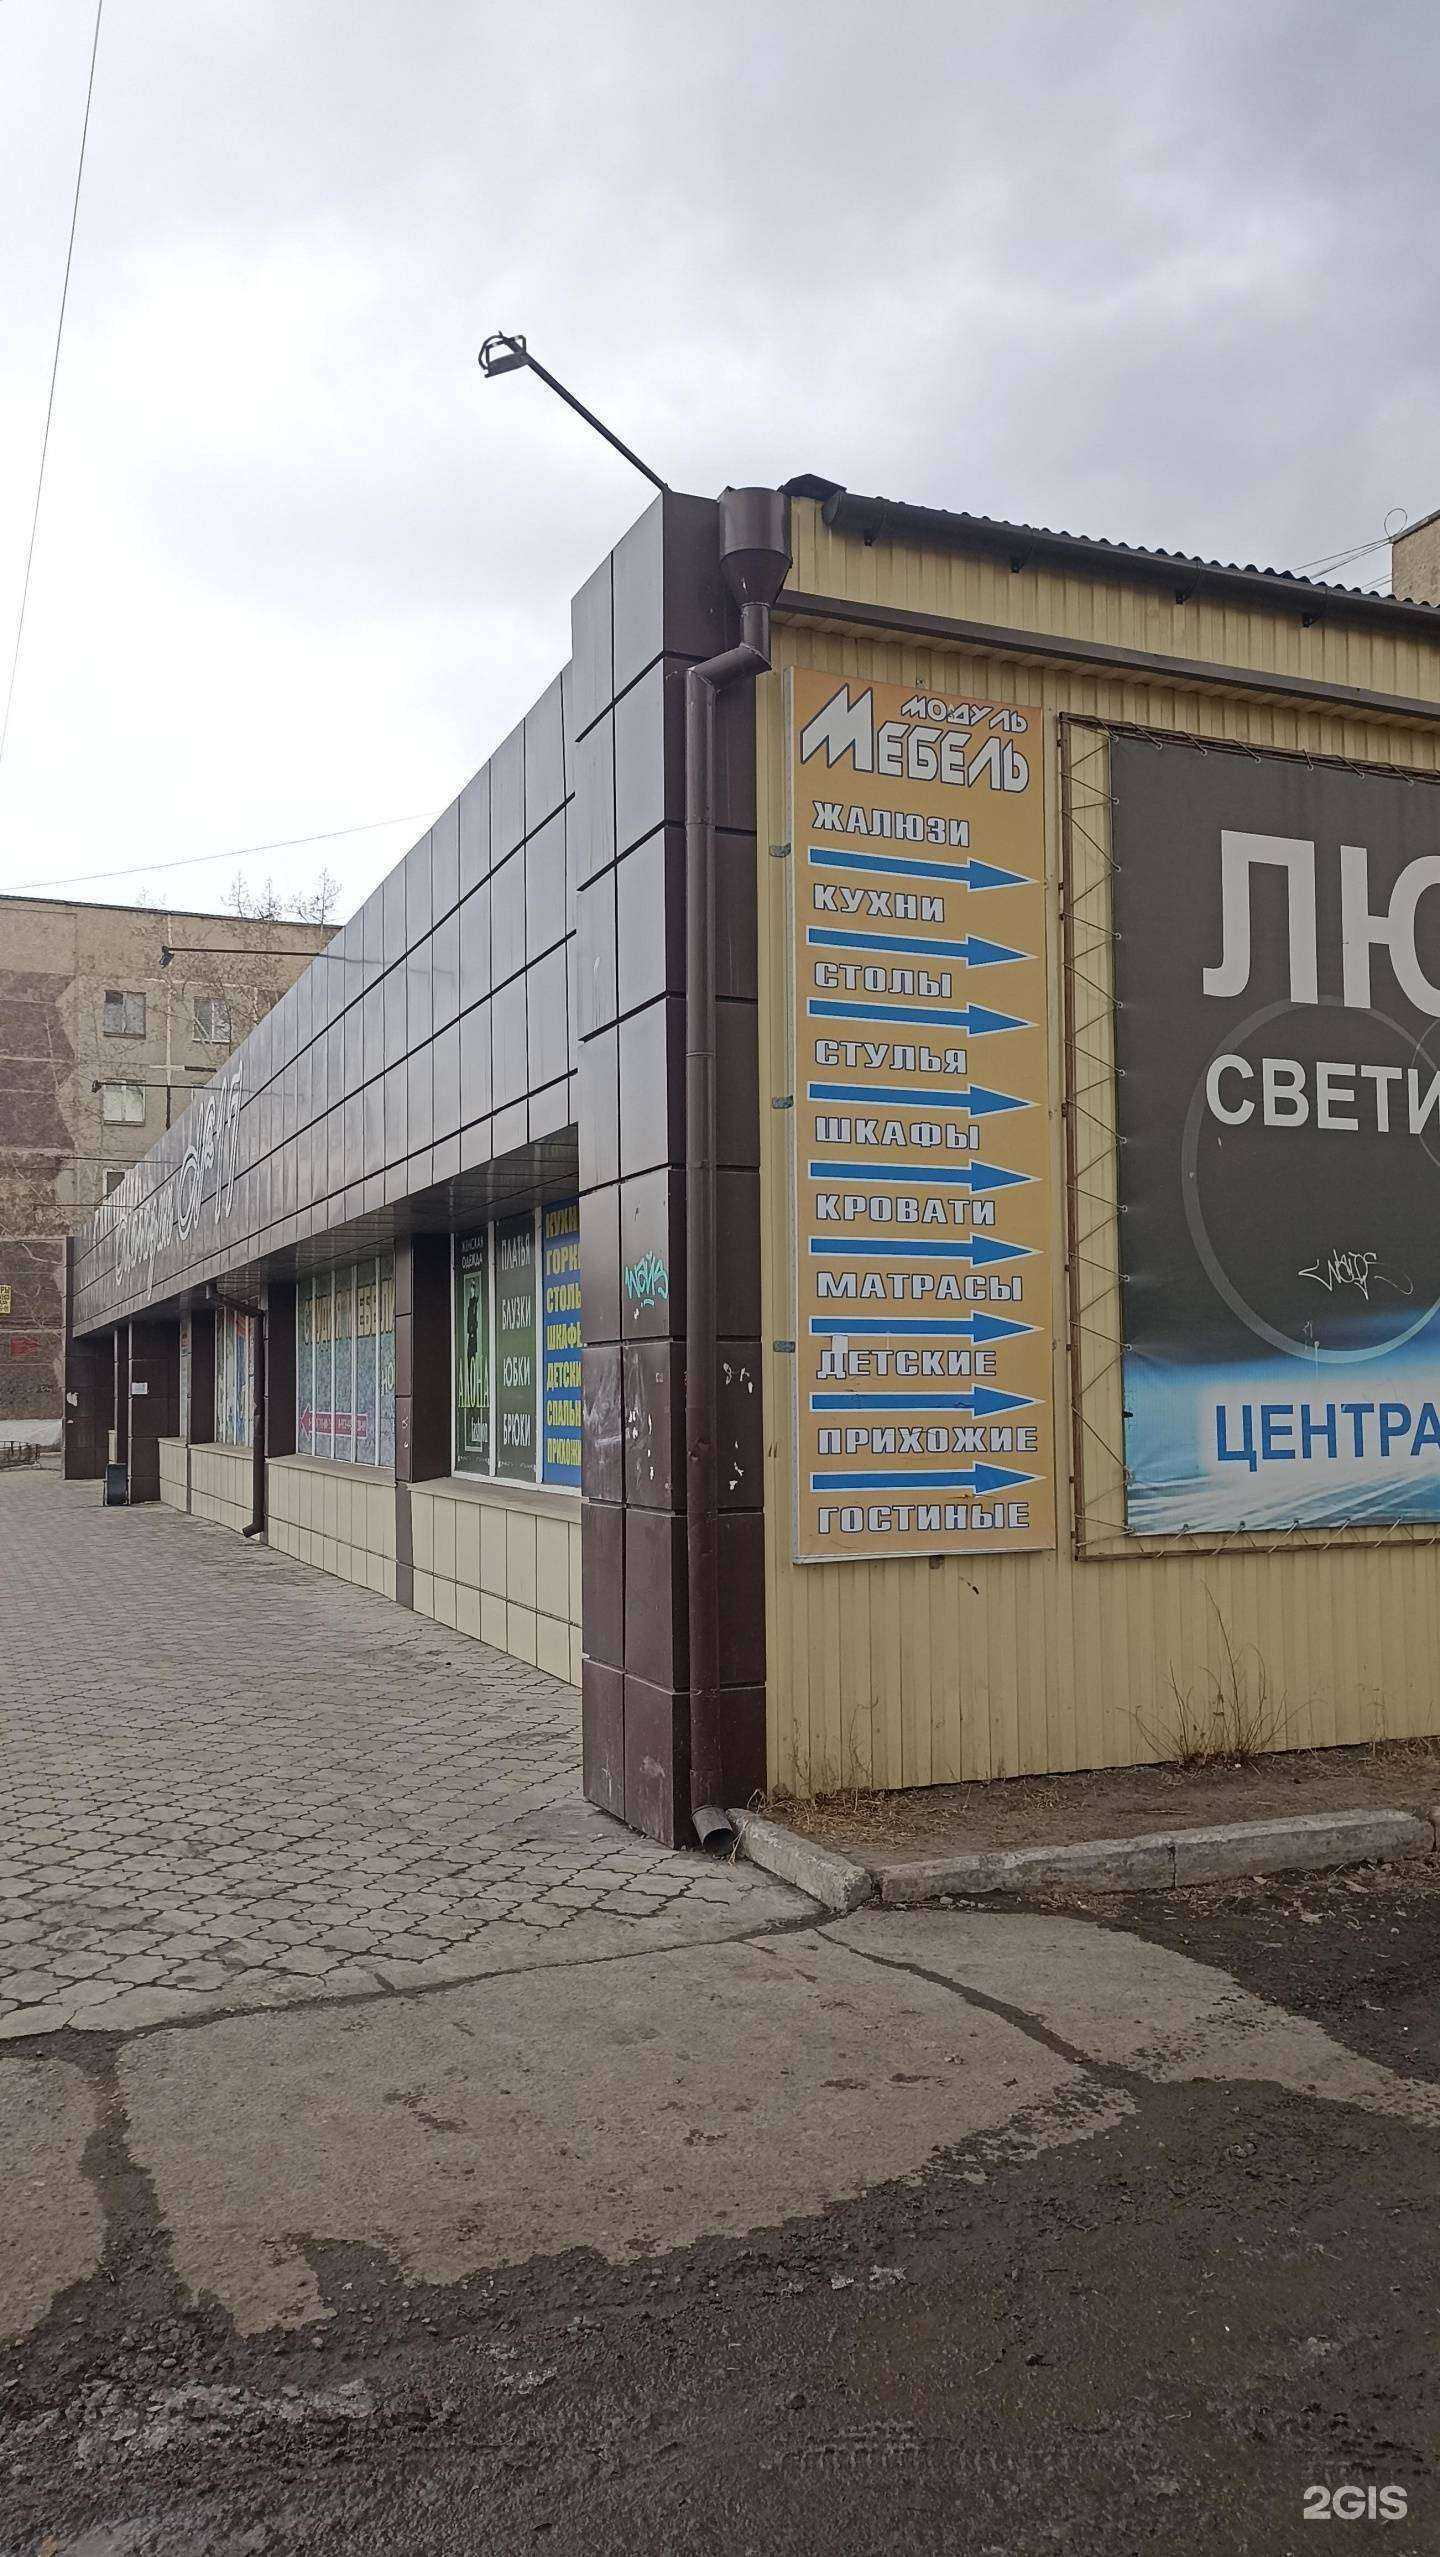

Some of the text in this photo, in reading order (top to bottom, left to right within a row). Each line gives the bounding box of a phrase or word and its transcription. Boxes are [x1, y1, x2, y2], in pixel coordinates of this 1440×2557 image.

[901, 694, 1028, 734] МОДУЛЬ
[800, 682, 1029, 793] МЕБЕЛЬ
[812, 801, 970, 847] ЖАЛЮЗИ
[813, 884, 945, 923] КУХНИ
[814, 961, 952, 998] СТОЛЫ
[814, 1039, 968, 1075] СТУЛЬЯ
[1205, 1054, 1440, 1135] СВЕТИ
[815, 1116, 980, 1151] ШКАФЫ
[816, 1193, 996, 1226] КРОВАТИ
[501, 1232, 531, 1271] ПЛАТЬЯ
[816, 1271, 1023, 1302] МАТРАСЫ
[501, 1295, 531, 1331] БЛУЗКИ
[503, 1356, 531, 1387] ЮБКИ
[816, 1349, 997, 1380] ДЕТСКИЕ
[503, 1413, 531, 1447] БРЮКИ
[817, 1426, 1038, 1455] ПРИХОЖИЕ
[1216, 1402, 1440, 1472] ЦЕНТРА
[817, 1503, 1030, 1534] ГОСТИНЫЕ
